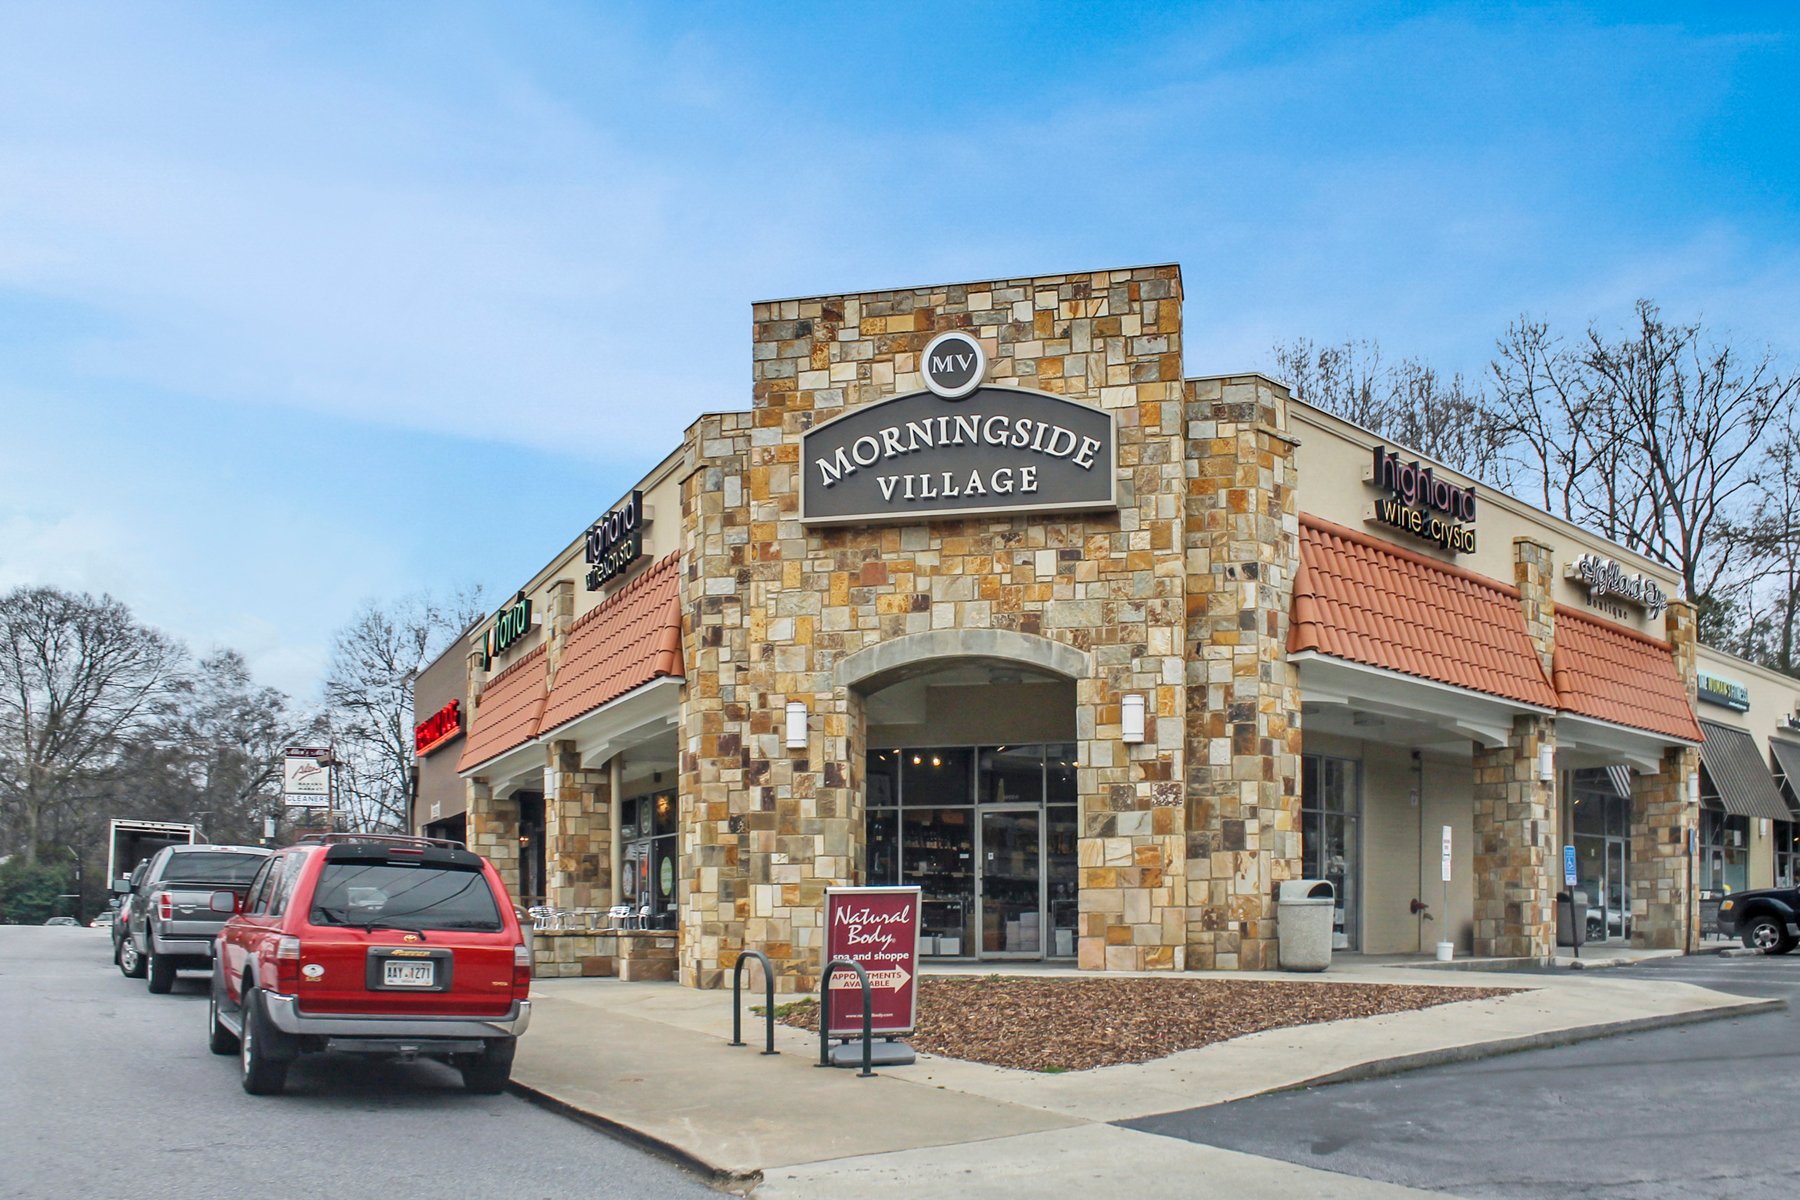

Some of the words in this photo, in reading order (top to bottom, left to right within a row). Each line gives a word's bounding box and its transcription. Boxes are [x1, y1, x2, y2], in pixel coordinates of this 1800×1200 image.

[931, 352, 975, 375] MV
[814, 414, 1102, 488] MORNINGSIDE
[876, 465, 1039, 502] VILLAGE
[834, 904, 910, 926] Natural
[847, 924, 892, 951] Body
[853, 951, 872, 961] and
[873, 951, 910, 962] shoppe
[831, 972, 902, 981] APPOITMENTS
[843, 980, 890, 988] AVAABLE
